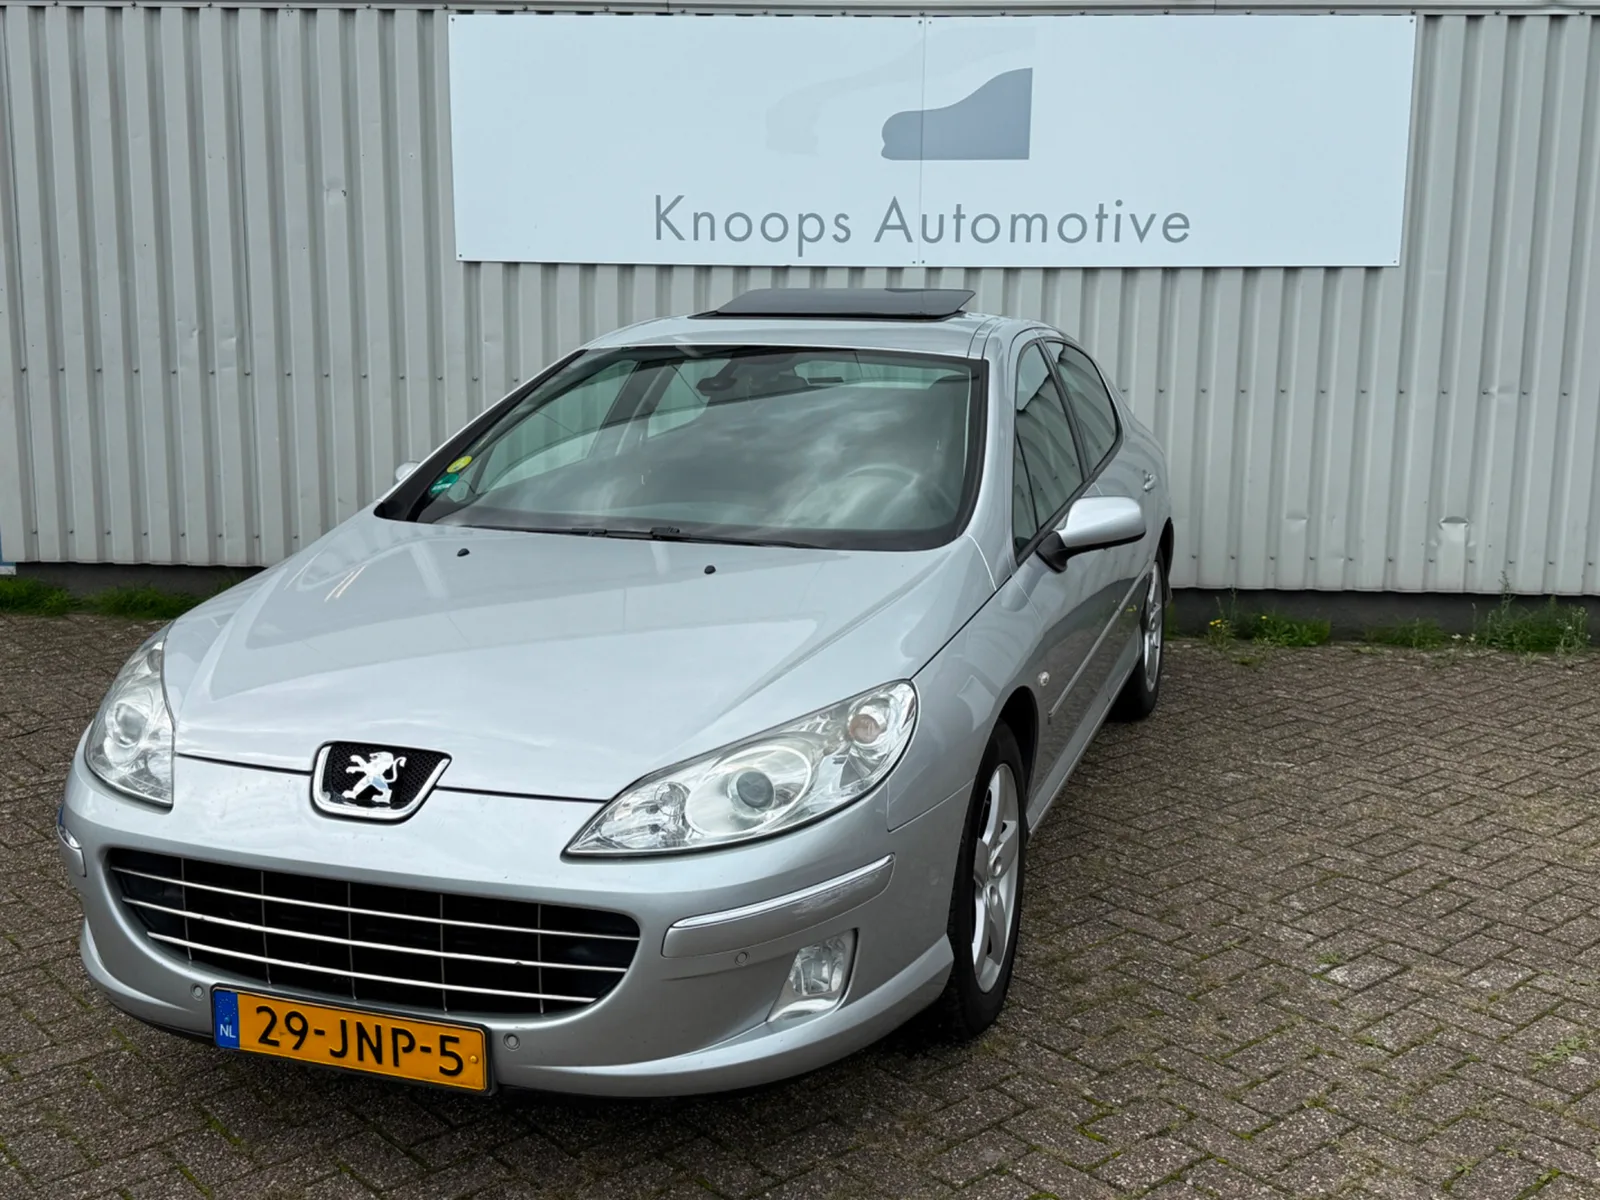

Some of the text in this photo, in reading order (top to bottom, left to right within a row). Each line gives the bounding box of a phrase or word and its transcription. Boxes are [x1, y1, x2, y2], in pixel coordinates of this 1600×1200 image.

[654, 194, 1191, 257] Knoops Automotive
[219, 1023, 237, 1039] NL
[255, 1005, 464, 1077] 29-JNP-5
